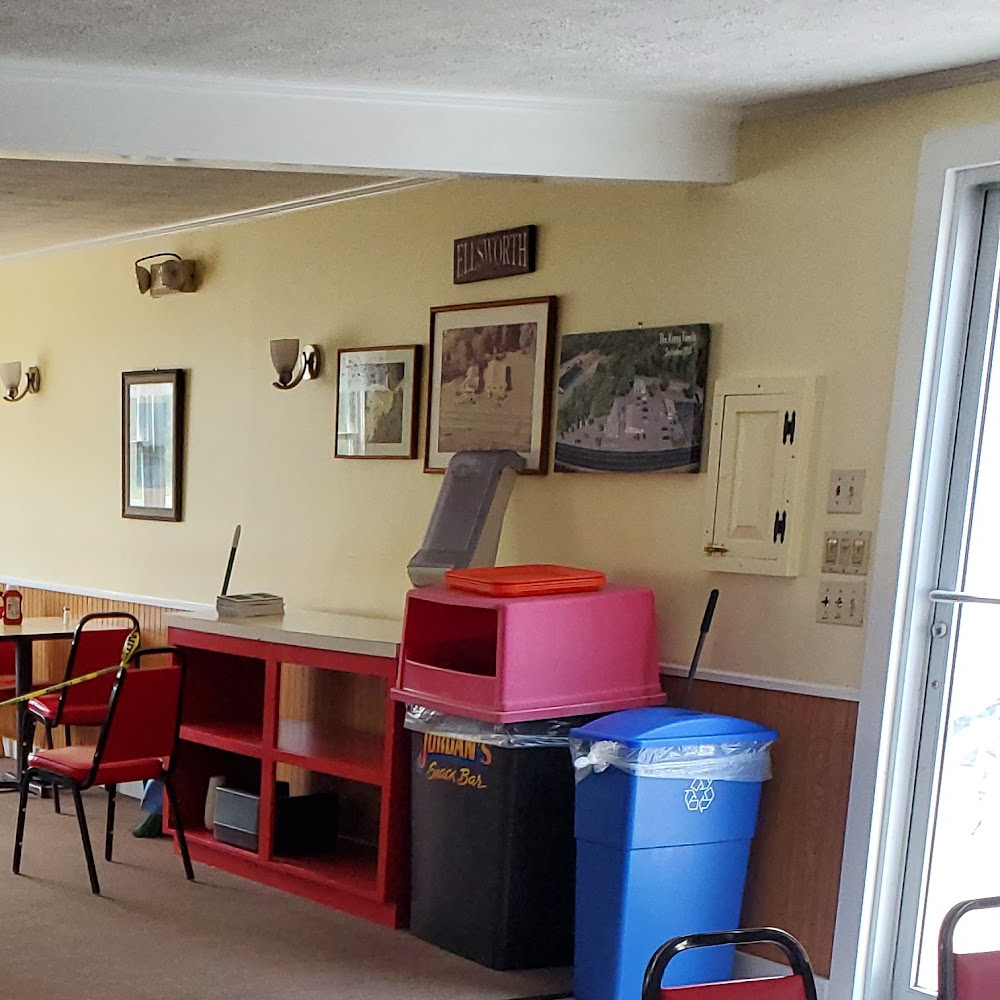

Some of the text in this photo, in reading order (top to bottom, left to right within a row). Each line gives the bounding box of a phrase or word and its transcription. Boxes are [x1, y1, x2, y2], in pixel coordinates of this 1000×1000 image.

[456, 231, 527, 279] ELLSWORTH
[418, 731, 493, 769] JORDAN'S
[427, 761, 488, 789] Snack Bar
